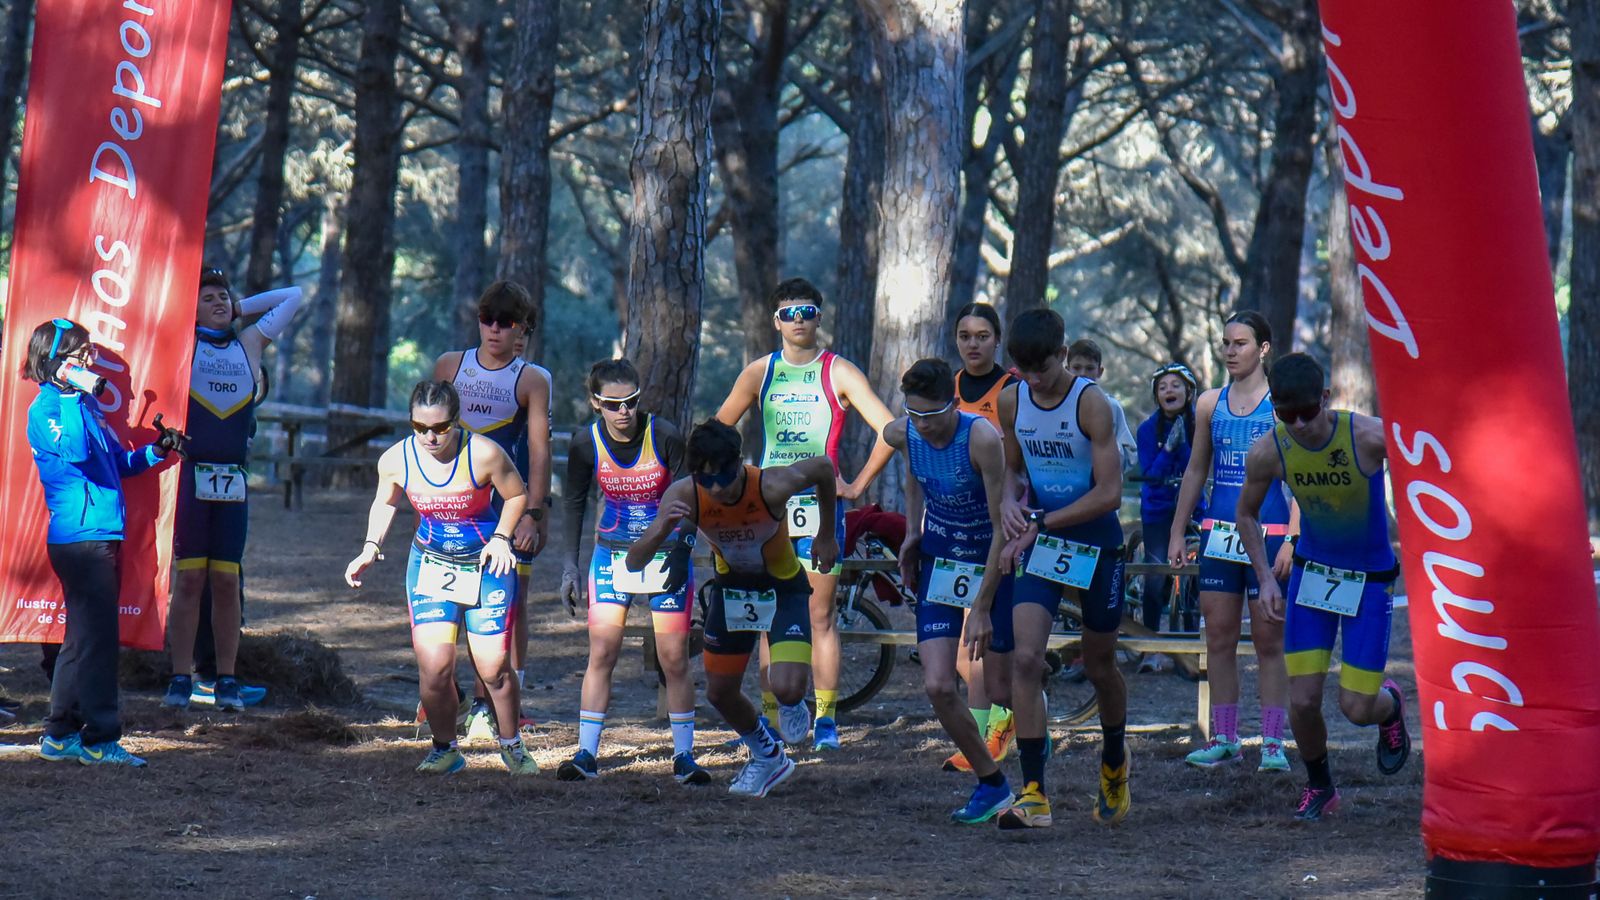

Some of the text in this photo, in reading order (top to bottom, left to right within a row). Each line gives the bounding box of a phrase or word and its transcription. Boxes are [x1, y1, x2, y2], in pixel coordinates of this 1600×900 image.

[208, 381, 238, 392] TORO
[463, 383, 511, 397] MONTEROS
[467, 403, 492, 414] JAVI
[776, 411, 811, 426] CASTRO
[769, 450, 816, 461] bike&you
[1024, 439, 1074, 459] VALENTIN
[1220, 450, 1248, 467] NIET
[209, 473, 234, 493] 17
[600, 471, 661, 484] CLUB TRIATLON
[1294, 471, 1352, 487] RAMOS
[606, 480, 658, 492] CHICLANA
[432, 494, 473, 504] TRIATLON
[416, 502, 470, 511] CHICLANA
[432, 511, 461, 520] RUIZ
[718, 528, 756, 543] ESPEJO
[1053, 553, 1073, 575] 5
[441, 572, 457, 592] 2
[953, 574, 970, 598] 6
[1326, 578, 1342, 602] 7
[16, 598, 57, 610] Ilustre
[37, 613, 53, 624] de
[744, 603, 759, 622] 3
